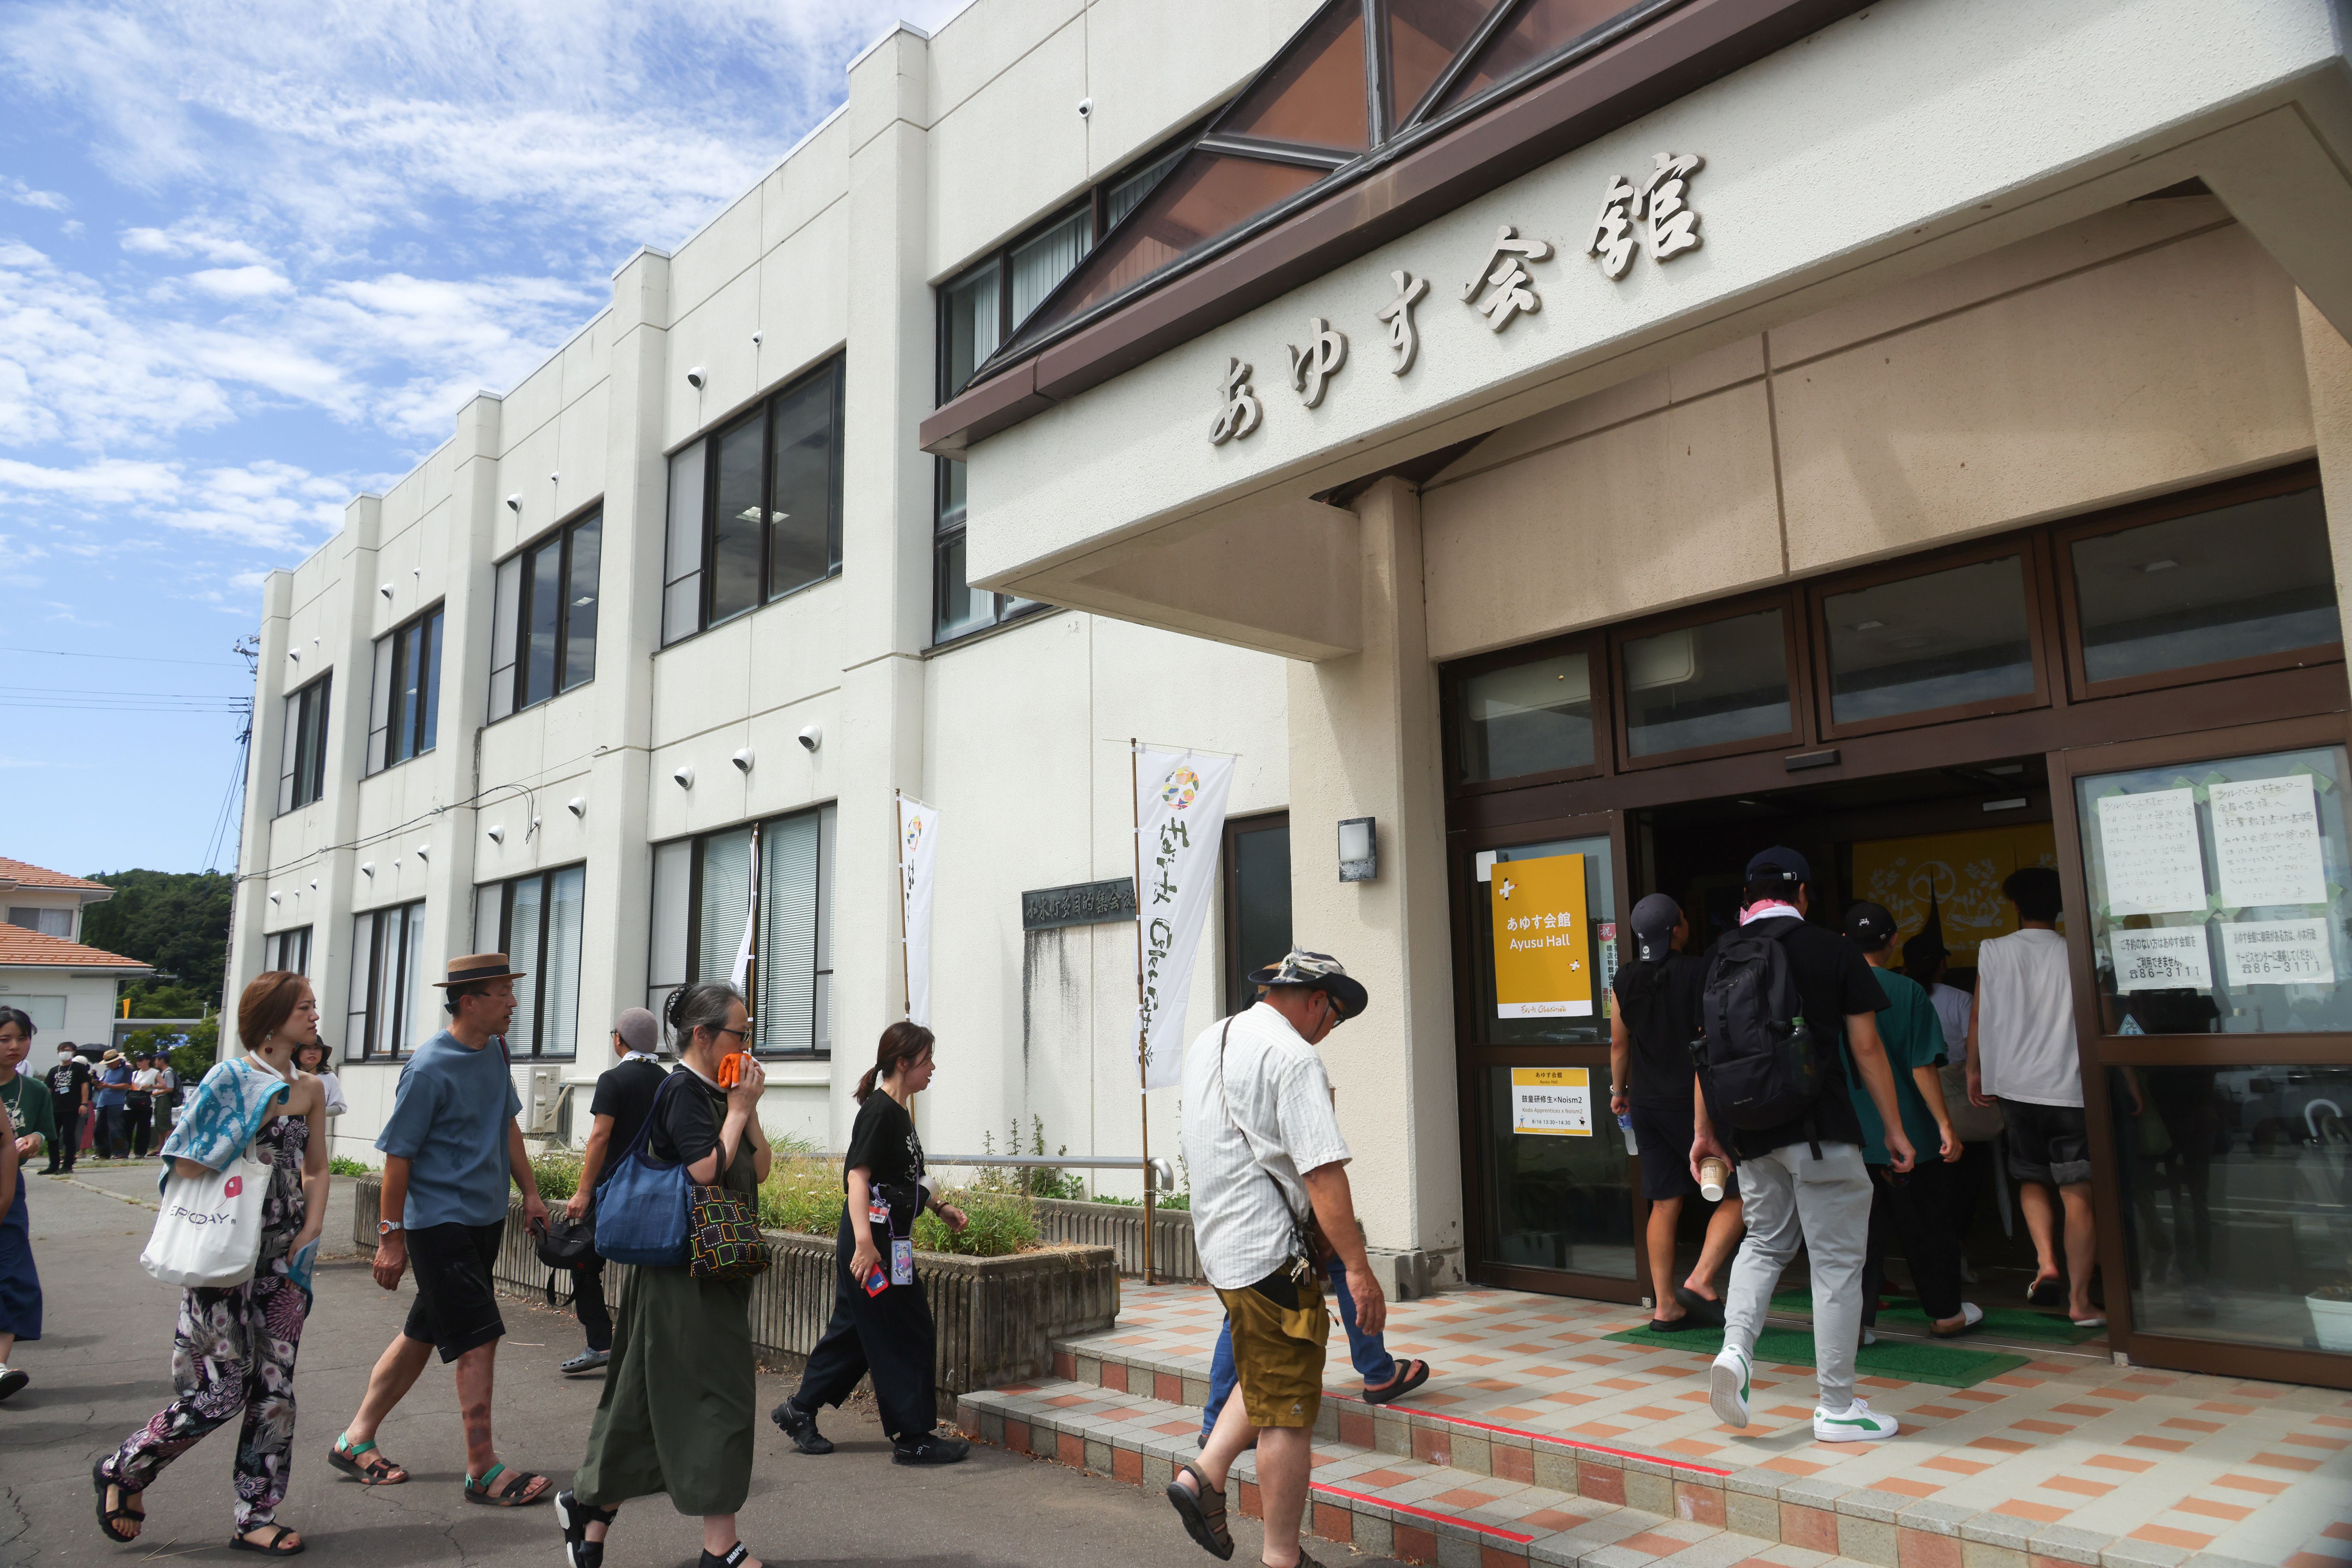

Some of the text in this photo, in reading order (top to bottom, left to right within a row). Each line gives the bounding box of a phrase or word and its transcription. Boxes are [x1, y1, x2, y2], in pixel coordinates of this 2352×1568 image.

[1208, 152, 1704, 445] あゆす会館
[1507, 912, 1571, 931] あゆす会館
[1600, 926, 1612, 937] 祝
[1510, 933, 1570, 952] Ayusu Hall
[2121, 935, 2196, 950] ご予約のない方はあゆす会館を
